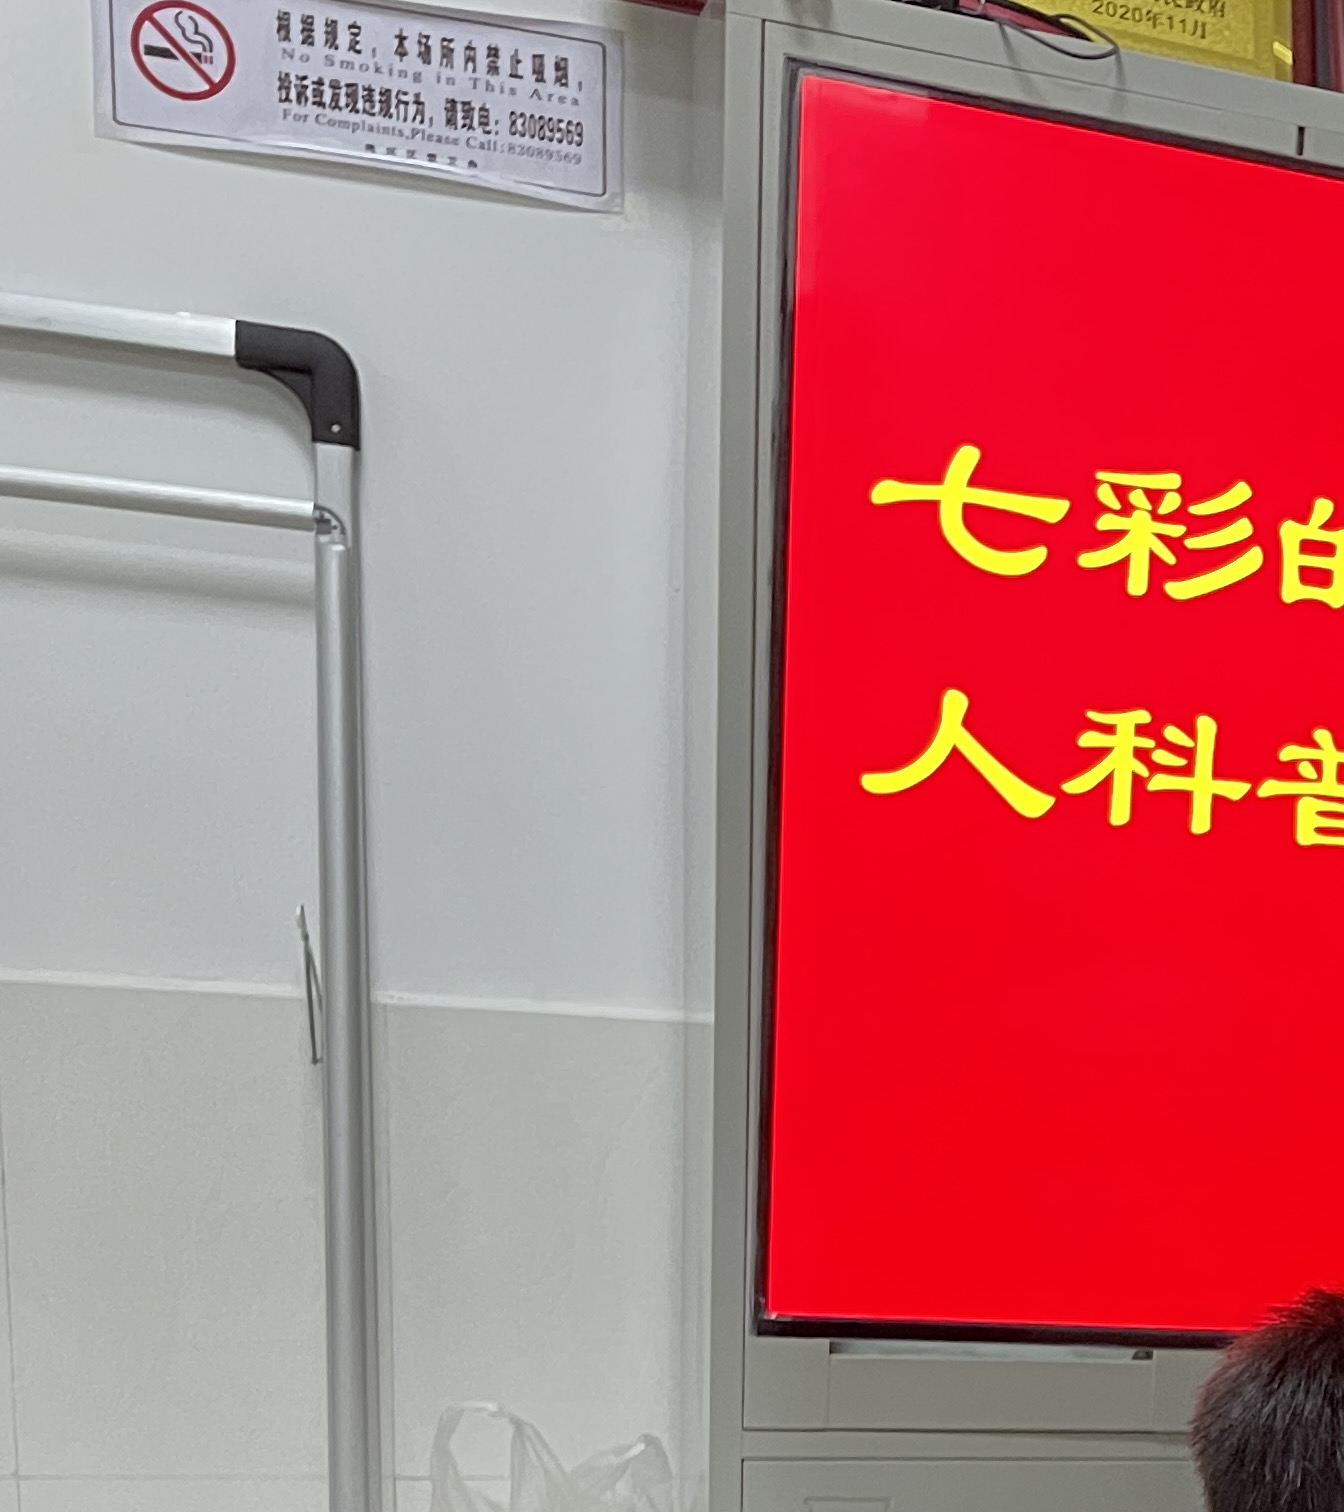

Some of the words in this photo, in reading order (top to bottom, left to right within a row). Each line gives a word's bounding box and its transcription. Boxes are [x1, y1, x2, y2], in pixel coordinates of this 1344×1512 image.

[281, 47, 311, 63] No
[324, 54, 423, 83] Smoking
[436, 71, 456, 87] in
[469, 77, 518, 95] This
